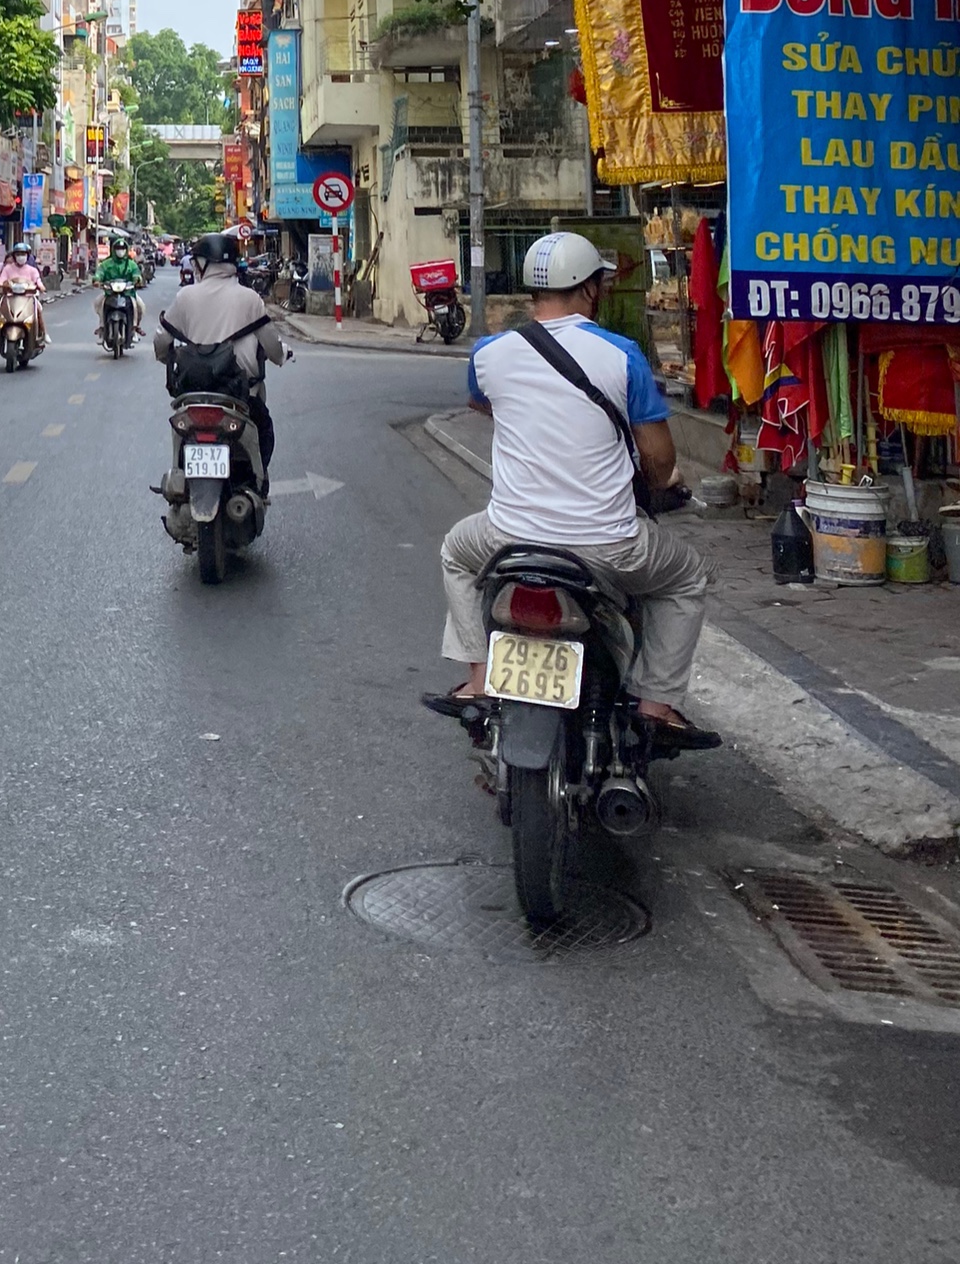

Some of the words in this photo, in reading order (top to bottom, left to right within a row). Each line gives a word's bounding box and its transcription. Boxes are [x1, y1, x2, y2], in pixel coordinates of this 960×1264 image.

[877, 41, 960, 76] CHỮ
[791, 90, 892, 121] THAY
[800, 137, 874, 167] LAU
[780, 184, 881, 216] THAY
[755, 223, 896, 264] CHỐNG
[748, 279, 800, 318] ĐT:
[810, 281, 960, 323] 0966.879
[187, 462, 227, 476] 519.10
[191, 448, 222, 461] 29-X7
[503, 639, 568, 671] 29-Z6
[500, 667, 566, 700] 2695
